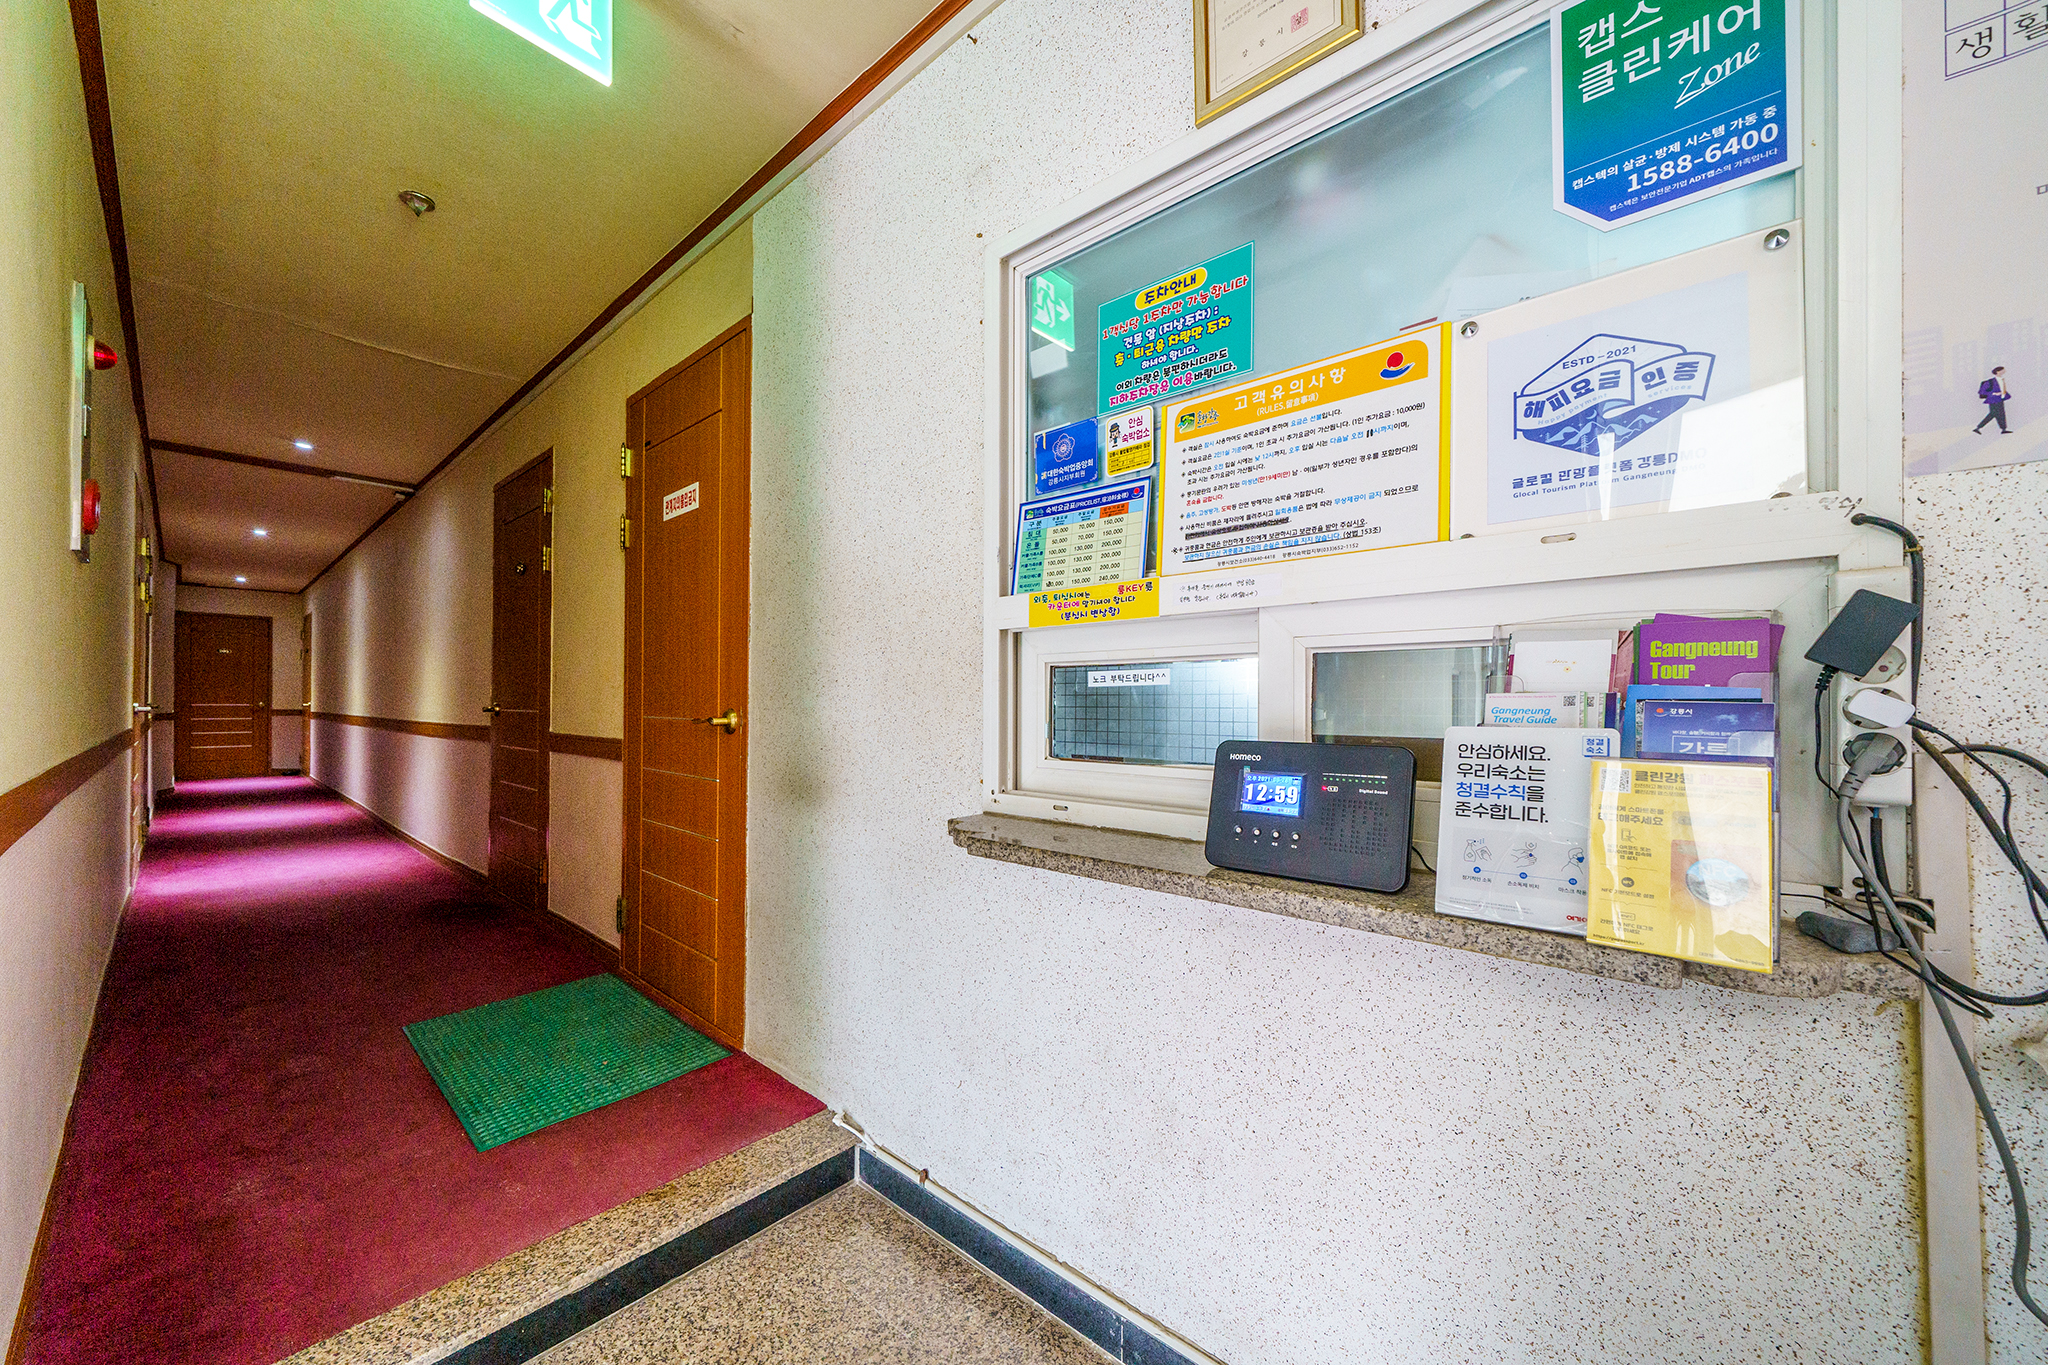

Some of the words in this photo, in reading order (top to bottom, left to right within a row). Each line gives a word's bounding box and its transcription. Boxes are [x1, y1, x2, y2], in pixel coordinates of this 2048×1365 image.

[1578, 0, 1663, 59] 캡스
[1578, 0, 1760, 103] 클린케어
[1676, 42, 1760, 103] Zone
[1572, 164, 1618, 190] 캡스텍의
[1685, 124, 1725, 148] 시스템
[1730, 112, 1758, 131] 가동
[1763, 105, 1778, 118] 중
[1627, 122, 1778, 192] 1588-6400
[1734, 147, 1778, 168] 가족입니다
[1144, 272, 1195, 305] 주차안내
[1103, 316, 1139, 340] 1객실당
[1143, 298, 1182, 325] 1주차만
[1186, 272, 1247, 309] 가능합니다
[1123, 332, 1142, 349] 건물
[1146, 327, 1155, 341] 앞
[1159, 306, 1210, 336] (지상주차)
[1168, 324, 1203, 348] 차량만
[1206, 313, 1230, 334] 주차
[1141, 353, 1166, 369] 하셔야
[1169, 341, 1198, 361] 합니다.
[1134, 370, 1159, 386] 차량은
[1163, 347, 1227, 377] 불편하시더라도
[1109, 378, 1168, 408] 지하주차장을
[1523, 370, 1621, 418] 해피요금
[1641, 361, 1700, 391] 인증
[1570, 393, 1608, 414] payment
[1648, 384, 1692, 398] services
[1128, 416, 1143, 428] 안심
[1122, 428, 1150, 442] 숙박업소
[1512, 472, 1553, 489] 글로컬
[1513, 488, 1538, 498] Glocal
[1542, 484, 1576, 494] Tourism
[1623, 468, 1676, 482] Gangneung
[1047, 600, 1079, 611] 카운터에
[1113, 593, 1135, 604] 합니다
[1650, 640, 1758, 660] Gangneung
[1092, 674, 1107, 684] 노크
[1650, 662, 1696, 679] Tour
[1492, 706, 1551, 718] Gangneung
[1494, 715, 1524, 724] Travel
[1526, 716, 1558, 724] Guide
[1458, 743, 1550, 762] 안심하세요.
[1586, 738, 1604, 746] 청결
[1586, 746, 1604, 754] 숙소
[1456, 762, 1546, 782] 우리숙소는
[1245, 784, 1298, 804] 12:59
[1456, 782, 1545, 802] 청결수칙을
[1454, 801, 1548, 823] 준수합니다.
